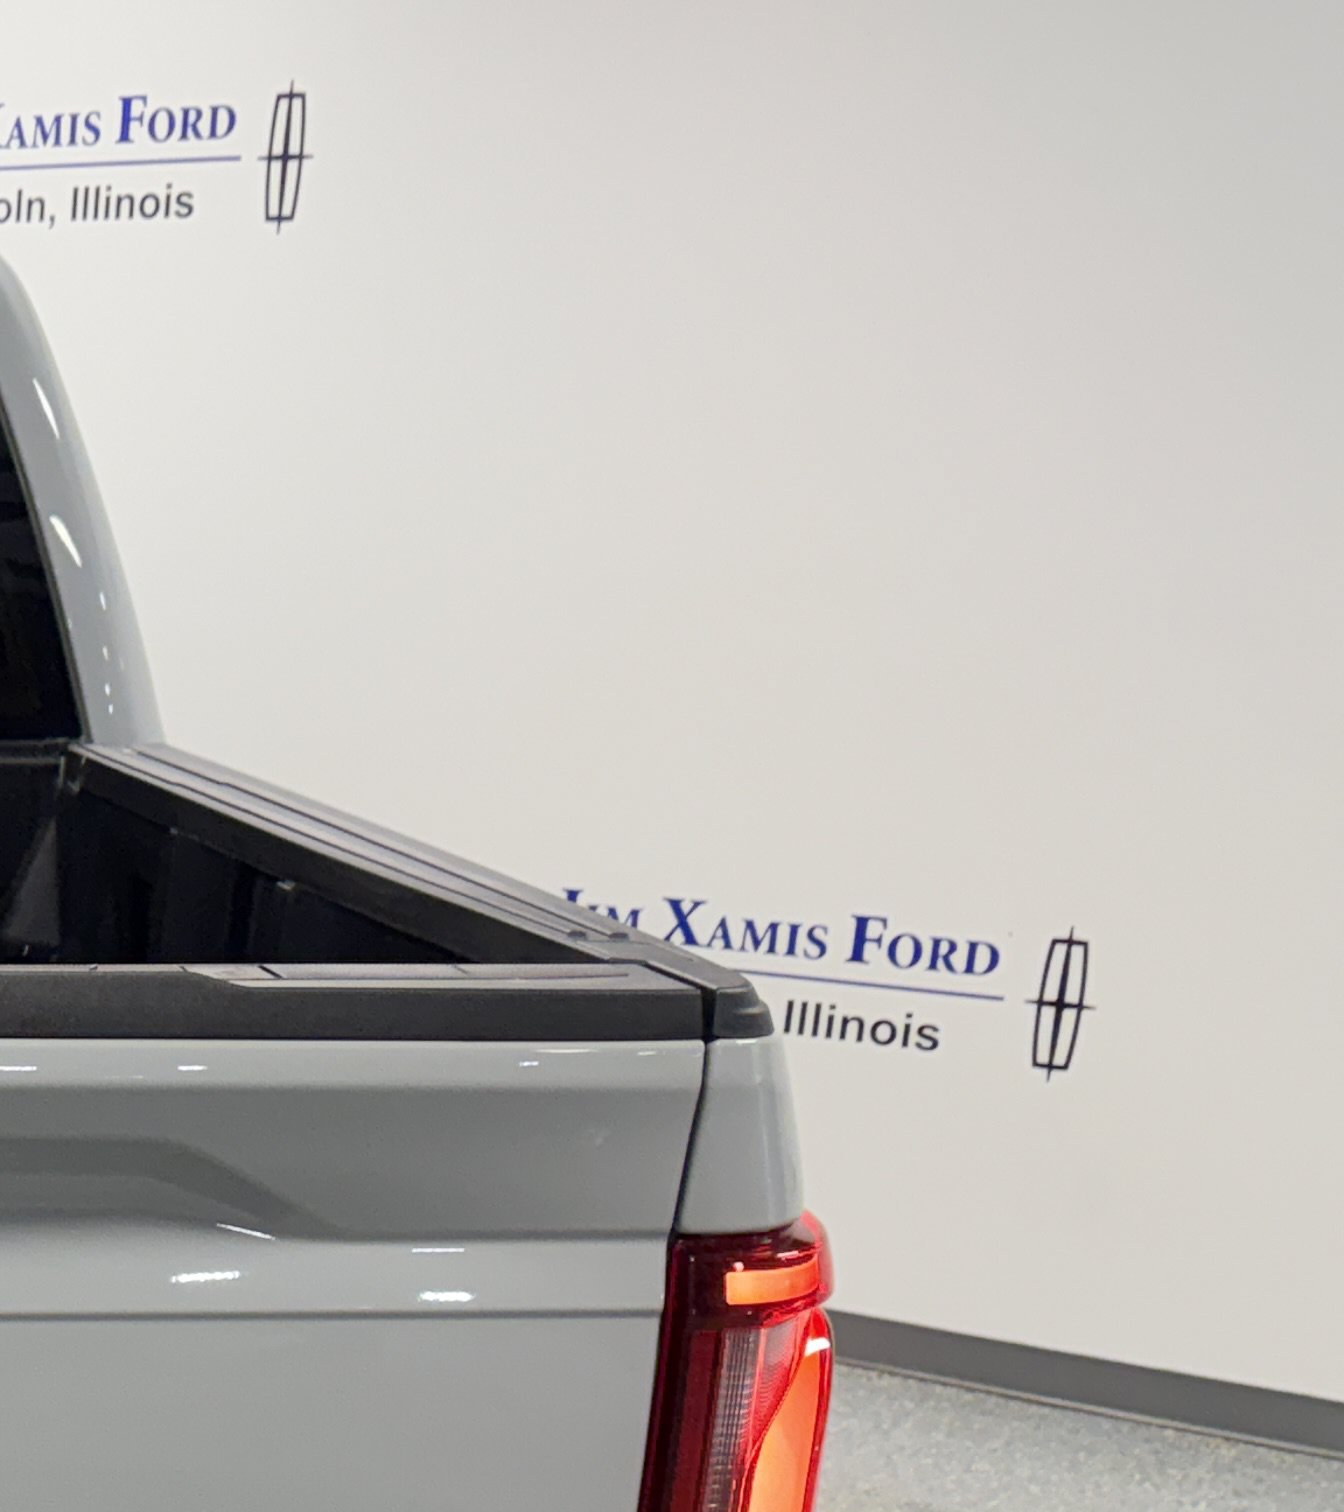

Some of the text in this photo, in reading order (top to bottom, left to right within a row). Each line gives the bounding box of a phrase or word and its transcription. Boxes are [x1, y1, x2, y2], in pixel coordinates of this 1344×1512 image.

[115, 94, 236, 144] FORD
[71, 182, 194, 222] Illinois
[663, 897, 829, 960] XAMIS
[845, 914, 1000, 976] FORD
[783, 1000, 940, 1051] Illinois
